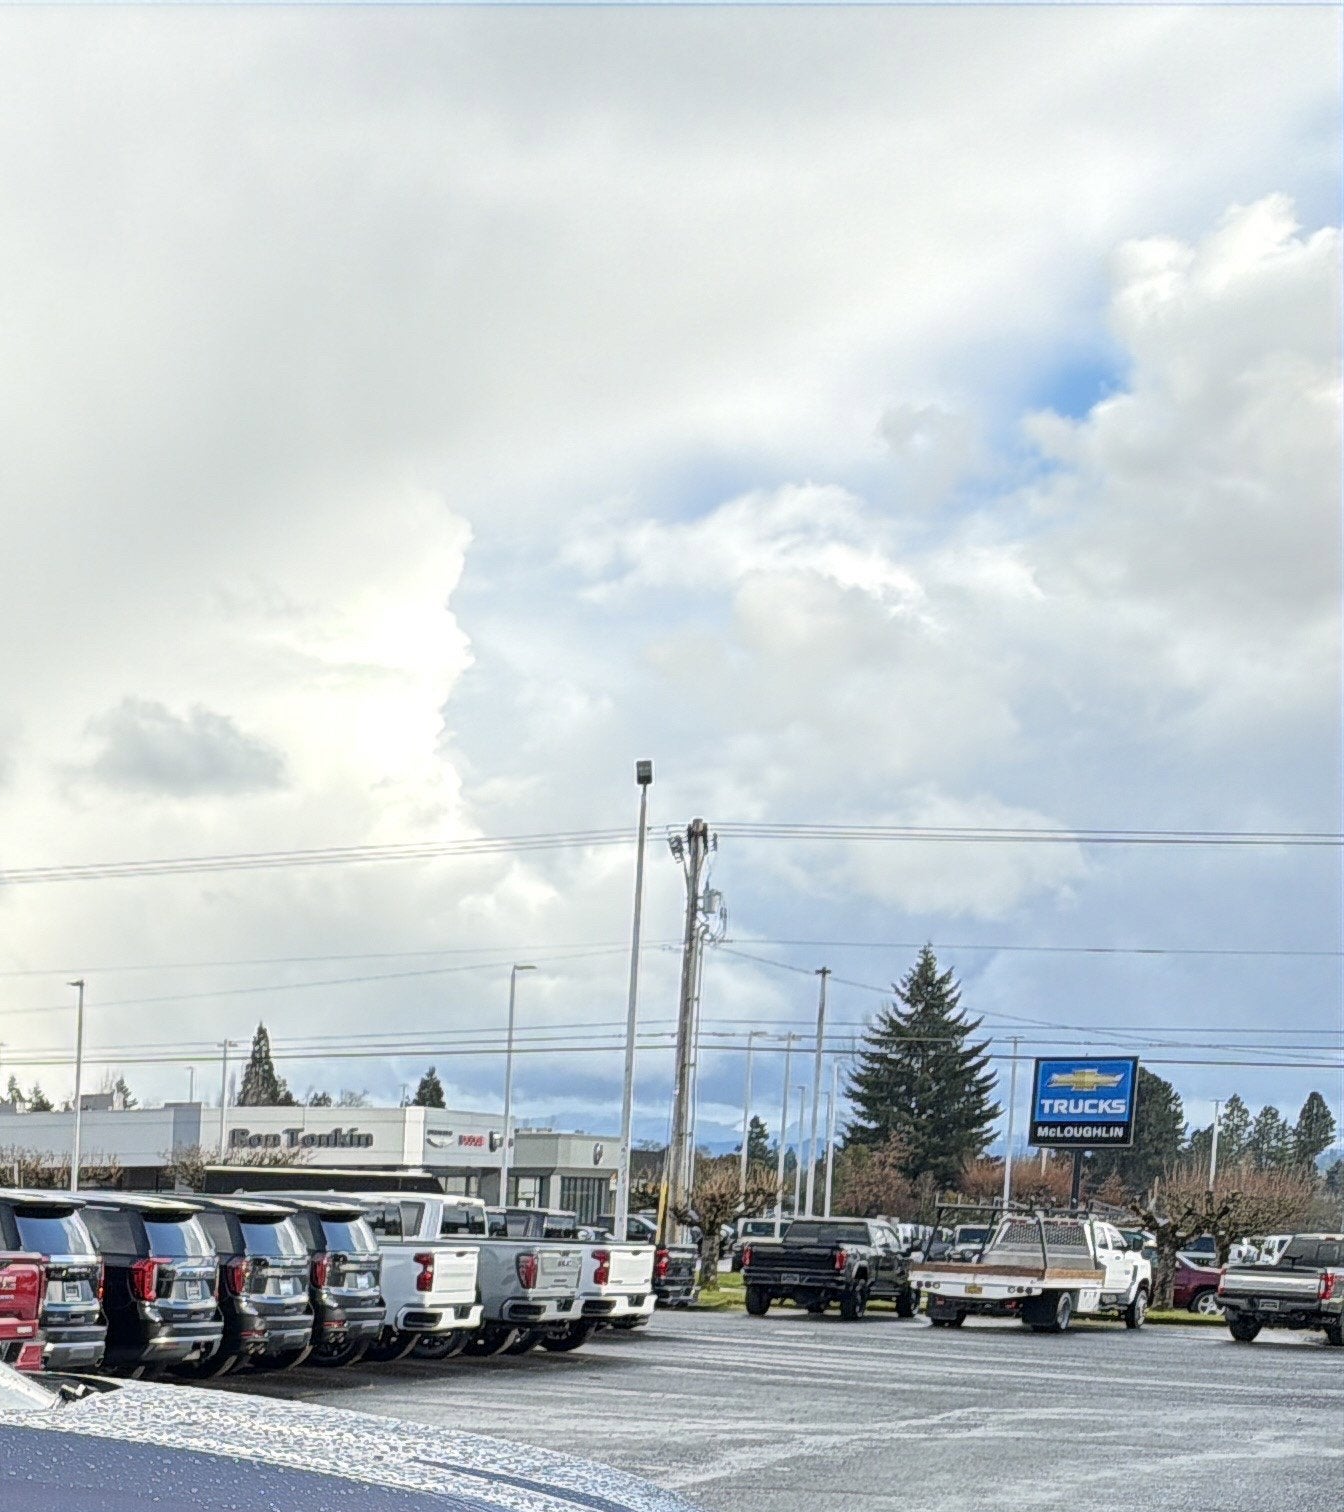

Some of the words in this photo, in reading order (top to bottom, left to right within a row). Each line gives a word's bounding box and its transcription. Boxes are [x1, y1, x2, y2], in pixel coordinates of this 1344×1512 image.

[1041, 1099, 1126, 1114] TRUCKS
[284, 1128, 373, 1148] Tonkin
[1037, 1126, 1123, 1138] McLOUGHLIN
